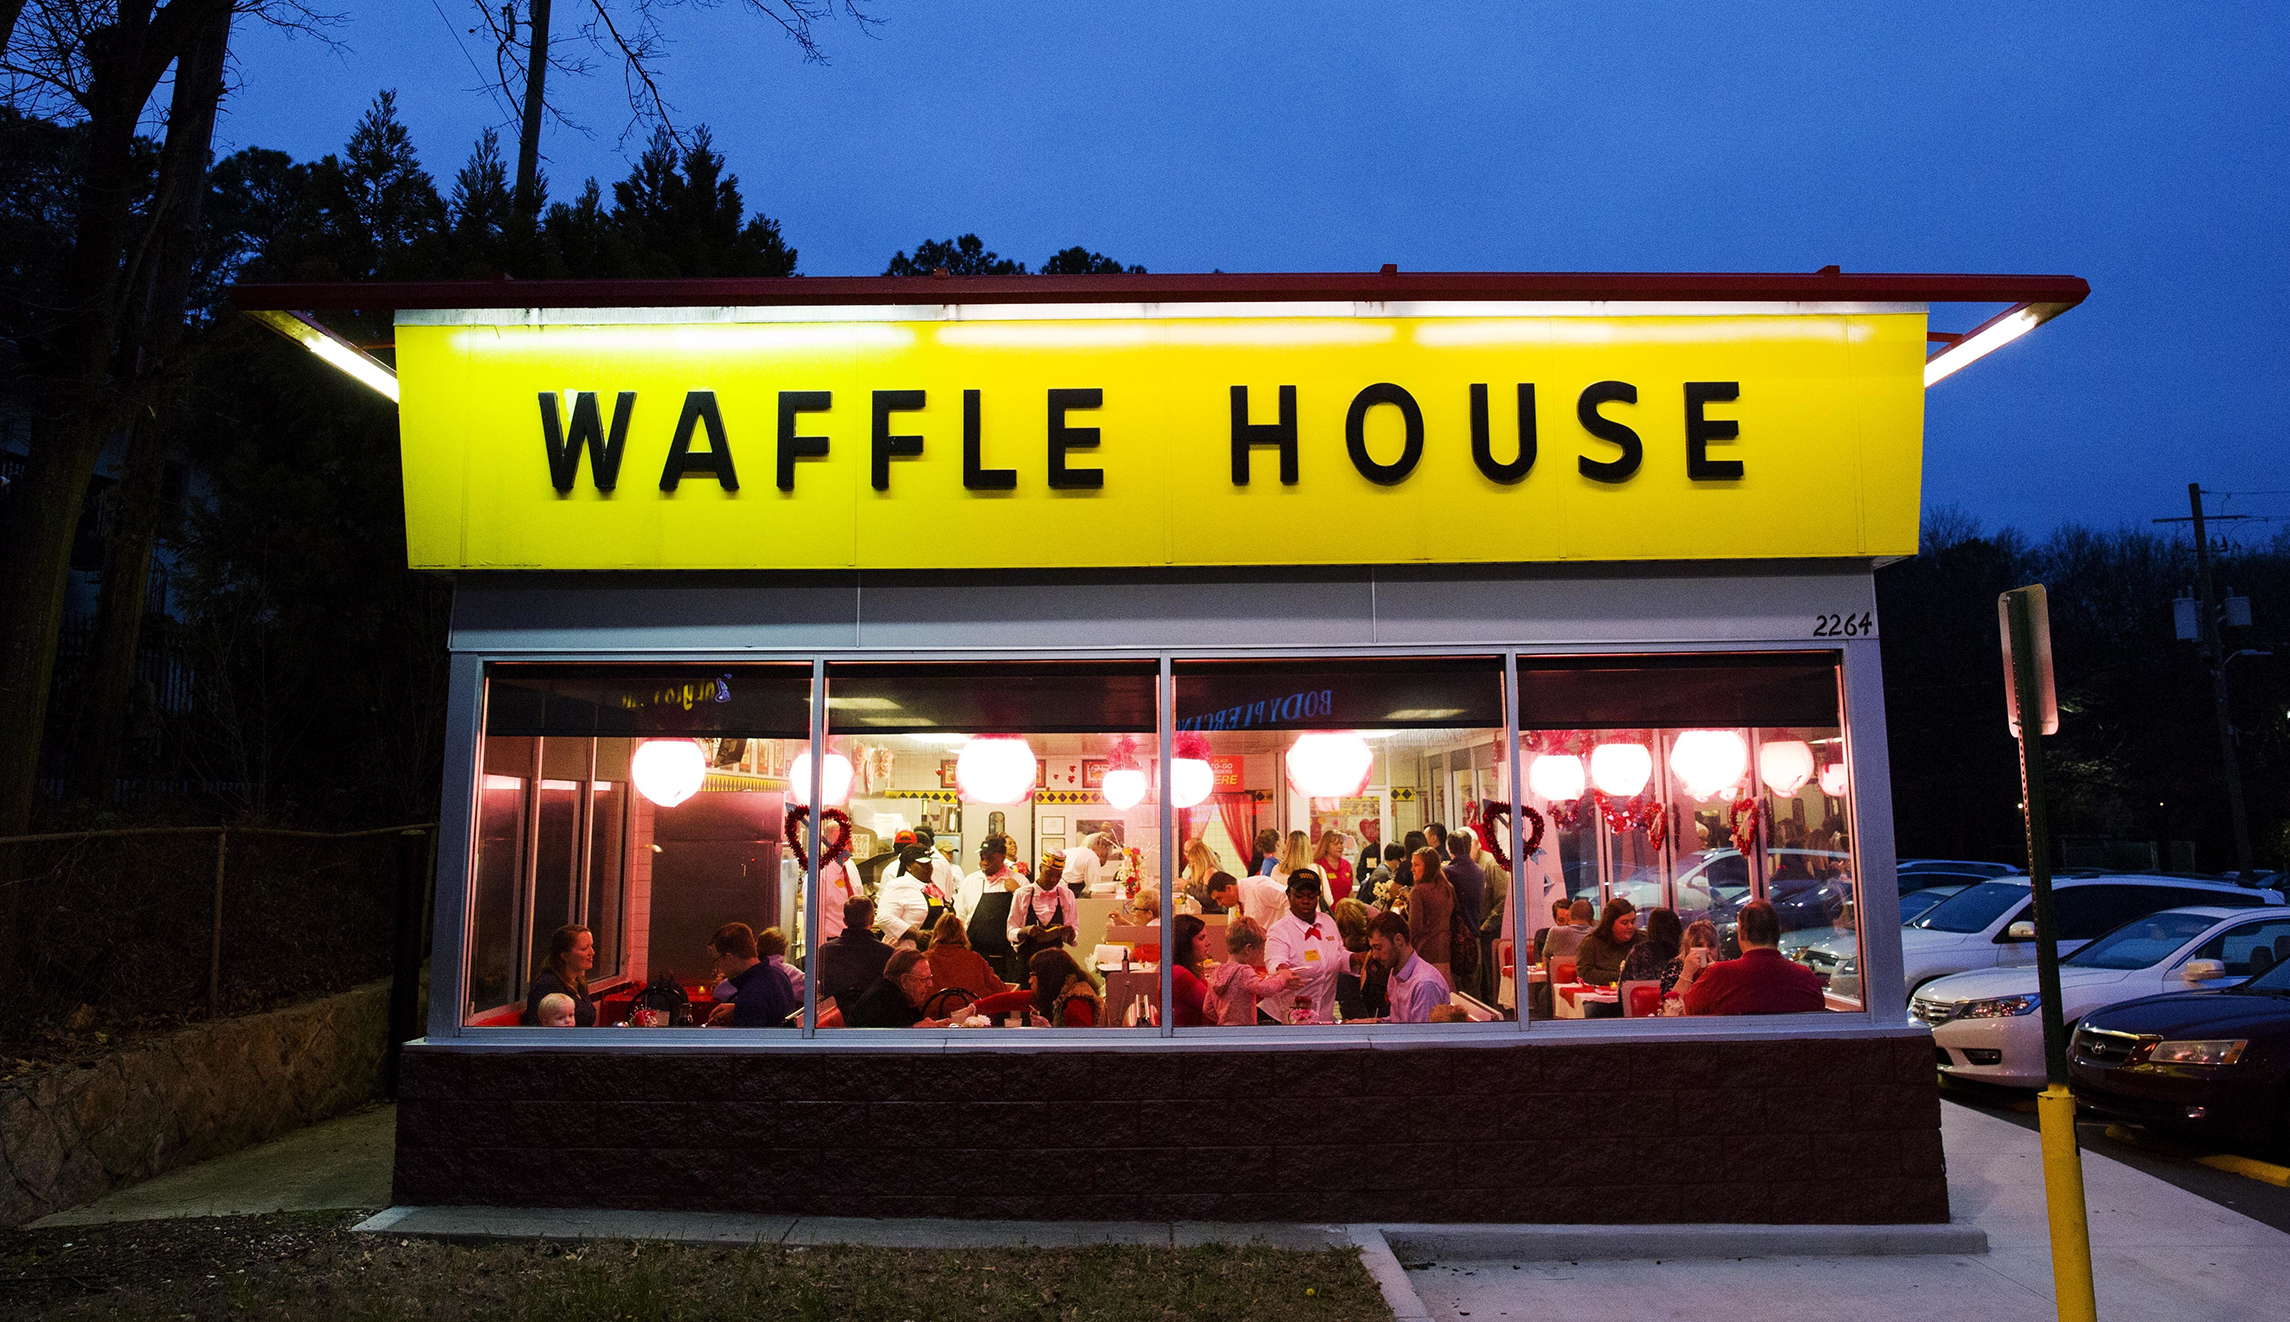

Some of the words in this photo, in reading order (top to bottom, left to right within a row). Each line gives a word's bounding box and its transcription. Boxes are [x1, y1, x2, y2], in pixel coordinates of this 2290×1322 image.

[538, 388, 1103, 500] WAFFLE
[1231, 380, 1744, 488] HOUSE
[1813, 611, 1873, 637] 2264
[1214, 774, 1238, 785] ERE
